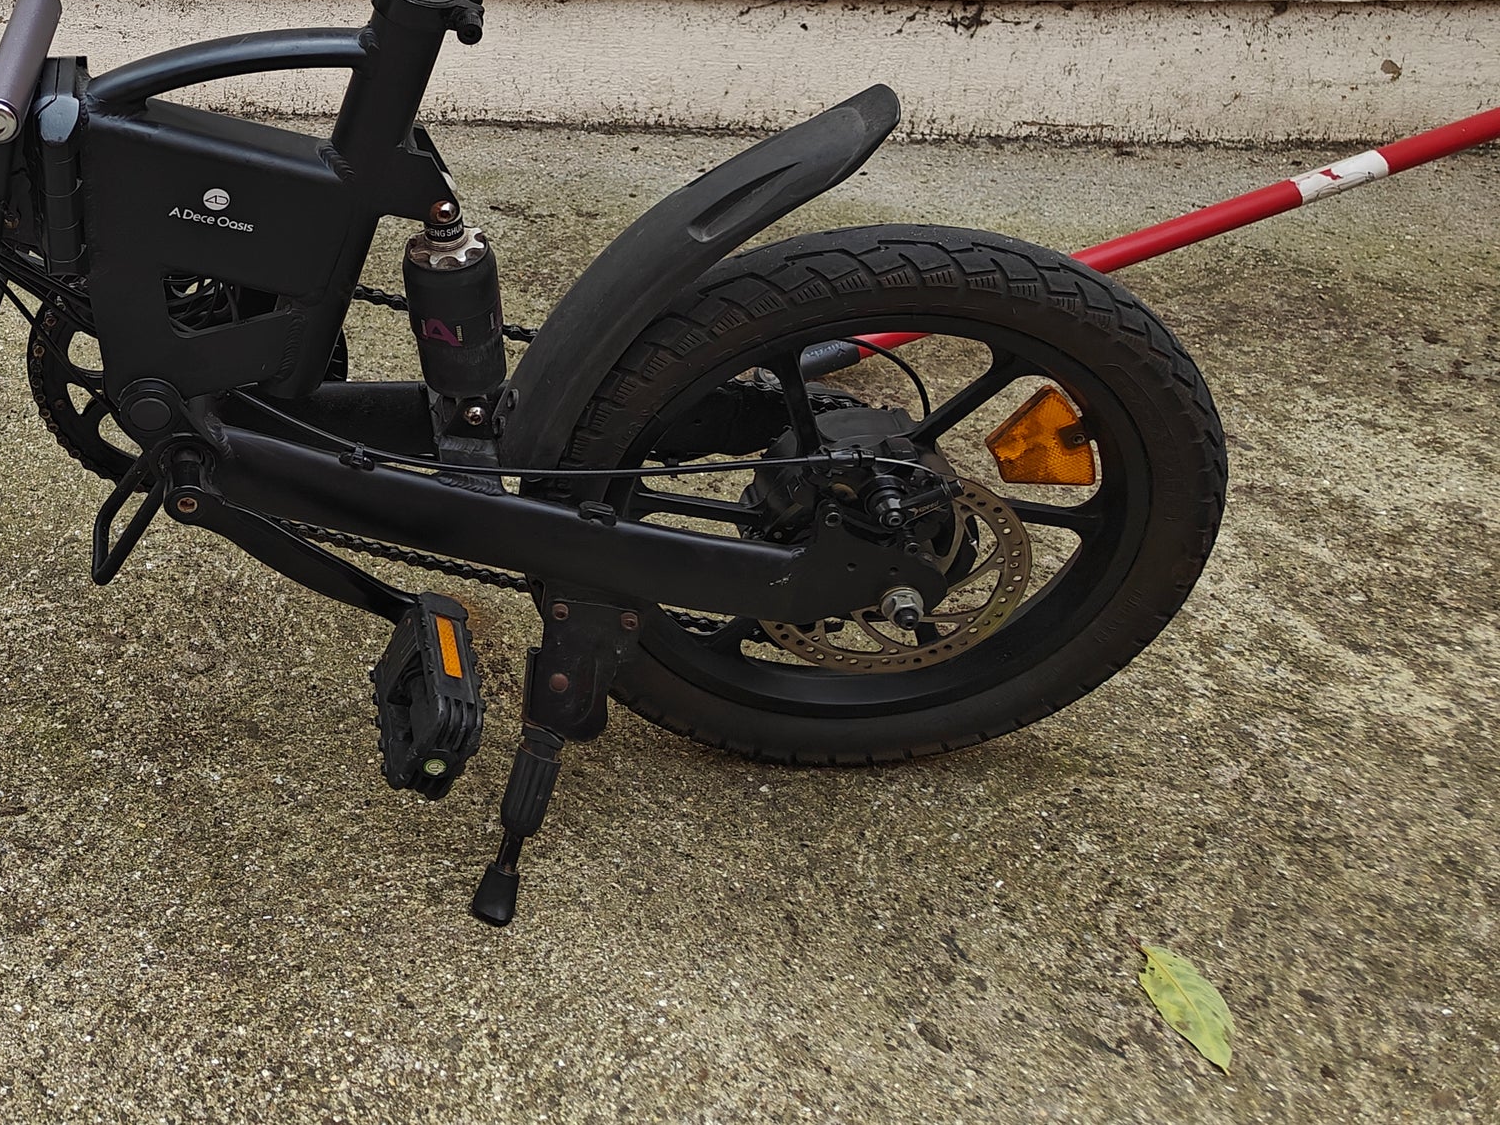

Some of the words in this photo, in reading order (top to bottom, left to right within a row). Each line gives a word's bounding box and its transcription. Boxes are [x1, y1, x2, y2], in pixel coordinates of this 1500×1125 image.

[168, 207, 181, 218] A
[182, 209, 215, 225] Dece
[217, 216, 254, 232] Oasis
